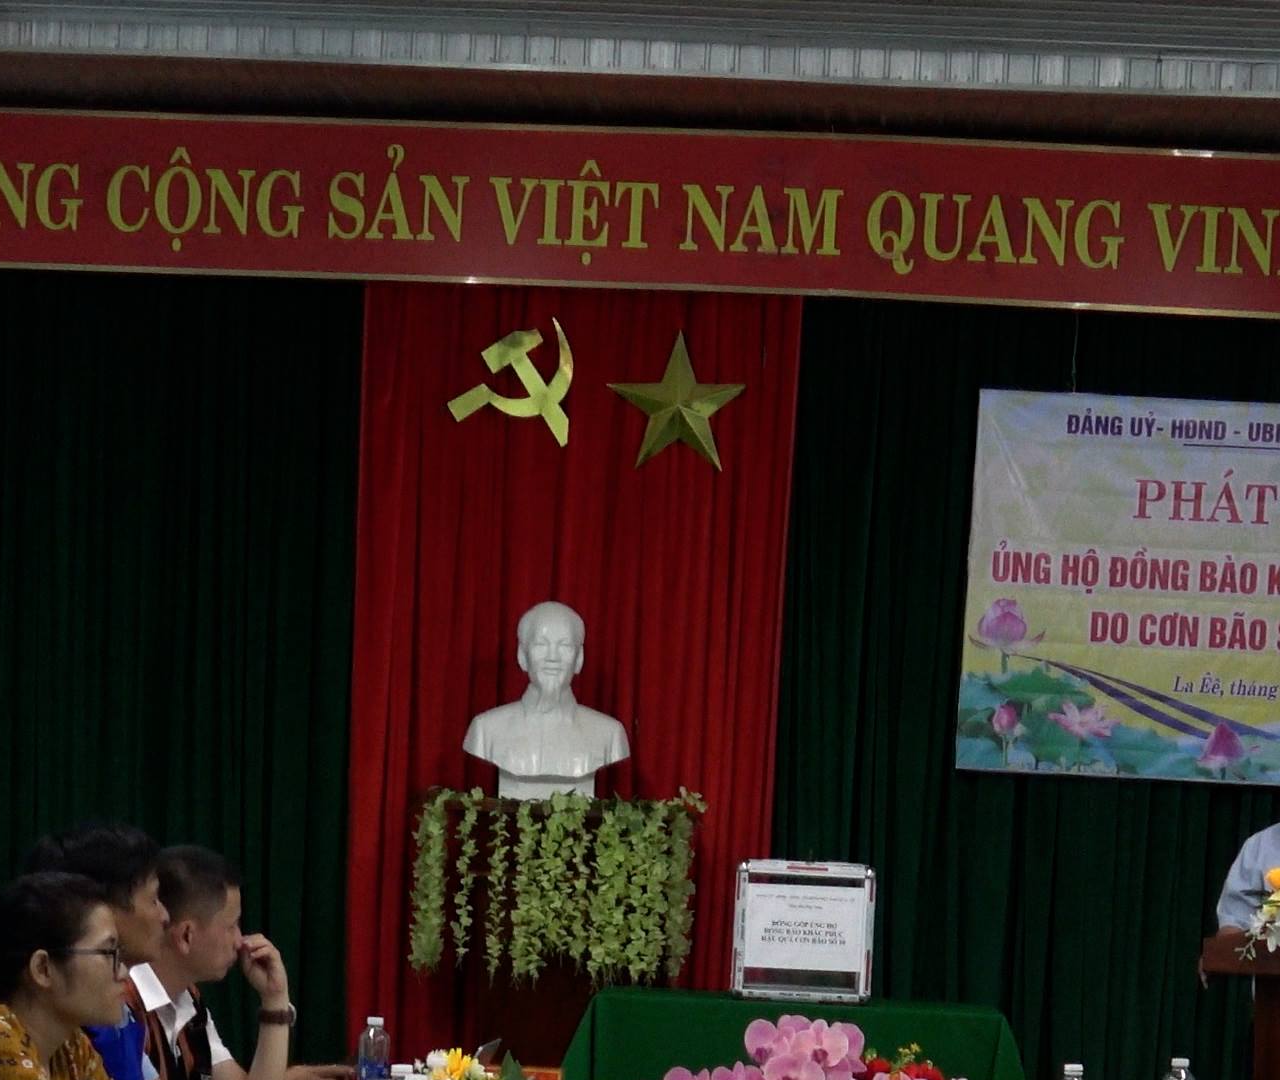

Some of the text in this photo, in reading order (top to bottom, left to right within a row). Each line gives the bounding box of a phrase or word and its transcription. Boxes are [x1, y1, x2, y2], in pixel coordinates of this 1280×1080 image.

[105, 146, 305, 252] CỘNG
[327, 144, 469, 243] SẢN
[489, 159, 660, 266] VIỆT
[679, 184, 843, 256] NAM
[866, 188, 1124, 277] QUANG
[1066, 408, 1123, 436] ĐẢNG
[1170, 419, 1227, 441] HĐND
[1132, 468, 1278, 525] PHÁT
[992, 539, 1052, 585] ỦNG
[1061, 548, 1100, 594] HỘ
[1109, 547, 1190, 592] ĐỒNG
[1199, 554, 1259, 595] BÀO
[1090, 611, 1129, 645] DO
[1138, 612, 1200, 648] CƠN
[1208, 611, 1268, 651] BÃO
[1173, 675, 1194, 693] La
[1230, 679, 1279, 701] tháng
